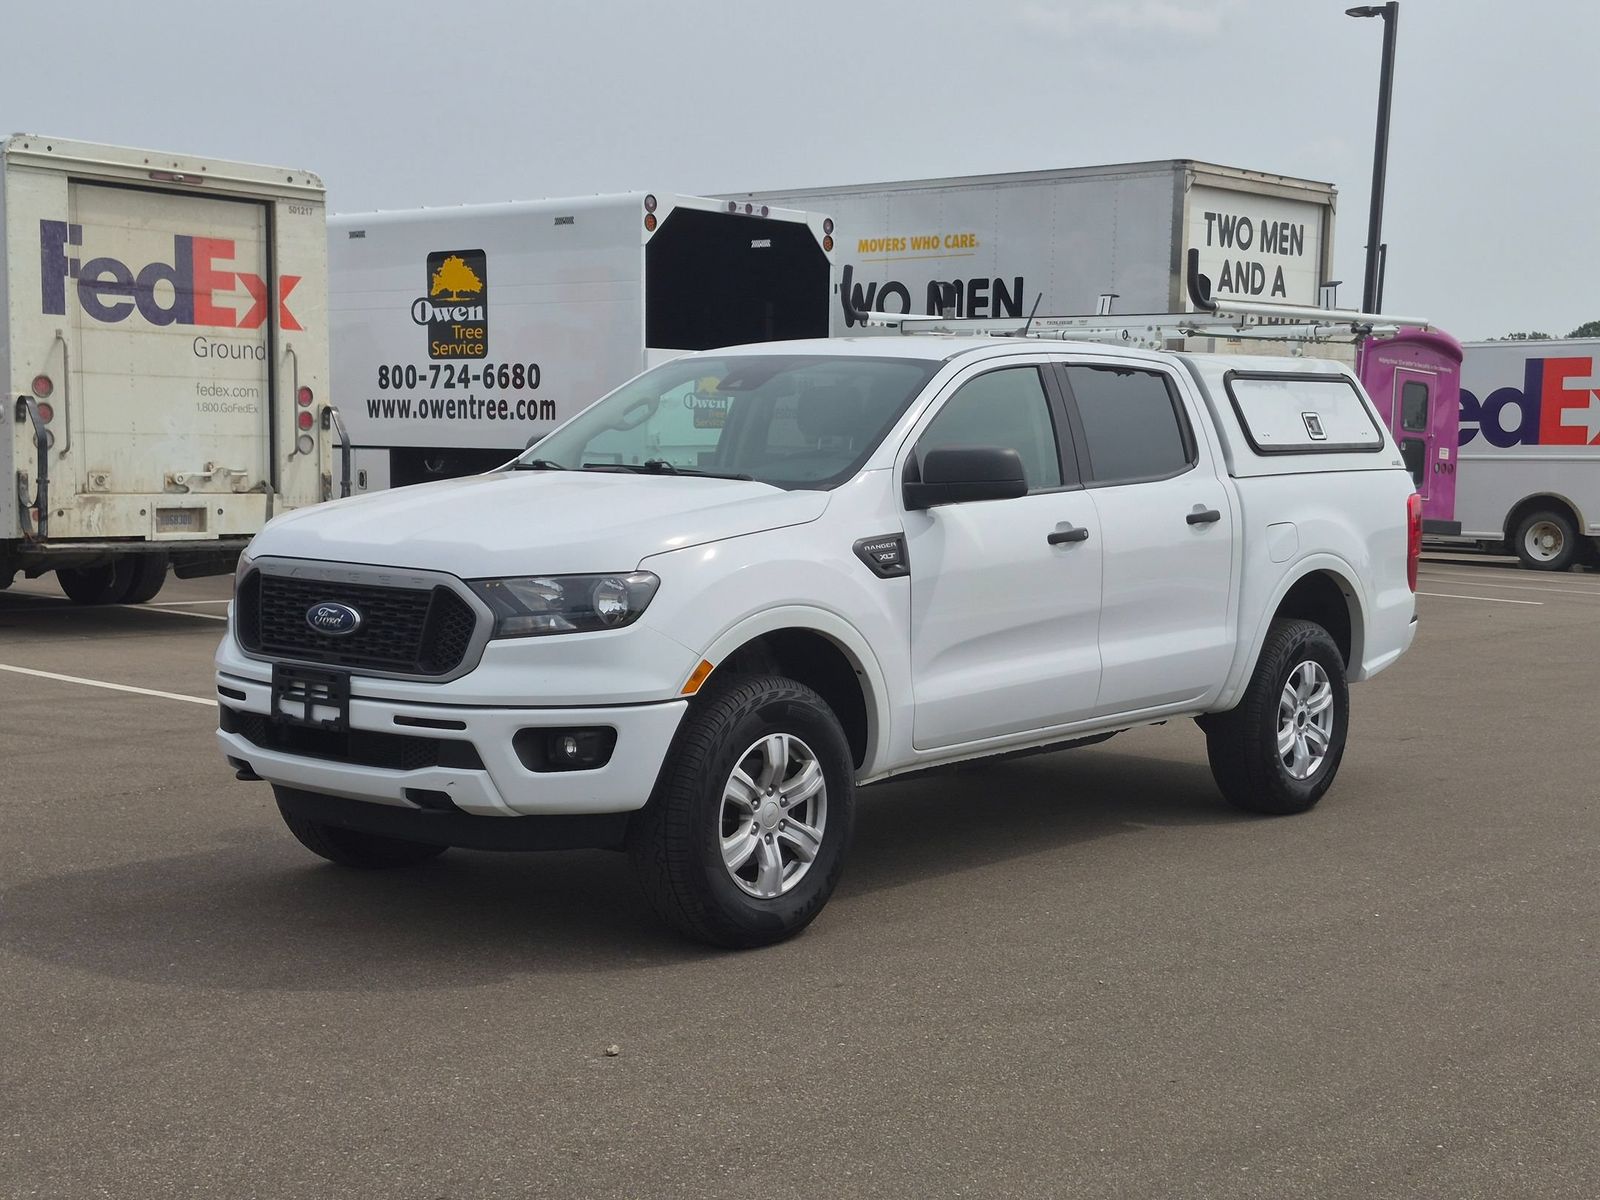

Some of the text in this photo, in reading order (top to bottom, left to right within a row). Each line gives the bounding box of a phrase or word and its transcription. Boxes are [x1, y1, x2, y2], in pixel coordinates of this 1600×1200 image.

[858, 238, 906, 253] MOVERS
[910, 235, 940, 250] WHO
[1204, 211, 1304, 257] TWO MEN
[40, 218, 304, 331] FedEx
[1217, 259, 1287, 298] AND A
[412, 298, 485, 325] Owen
[451, 325, 483, 340] Tree
[193, 336, 267, 361] Ground
[432, 340, 484, 356] Service
[378, 363, 541, 390] 800-724-6680
[196, 382, 259, 398] fedex.com
[1458, 357, 1600, 448] edE
[366, 394, 557, 421] www.owentree.com
[863, 541, 897, 551] RANGER
[880, 552, 896, 560] XLT
[314, 607, 345, 625] Ford
